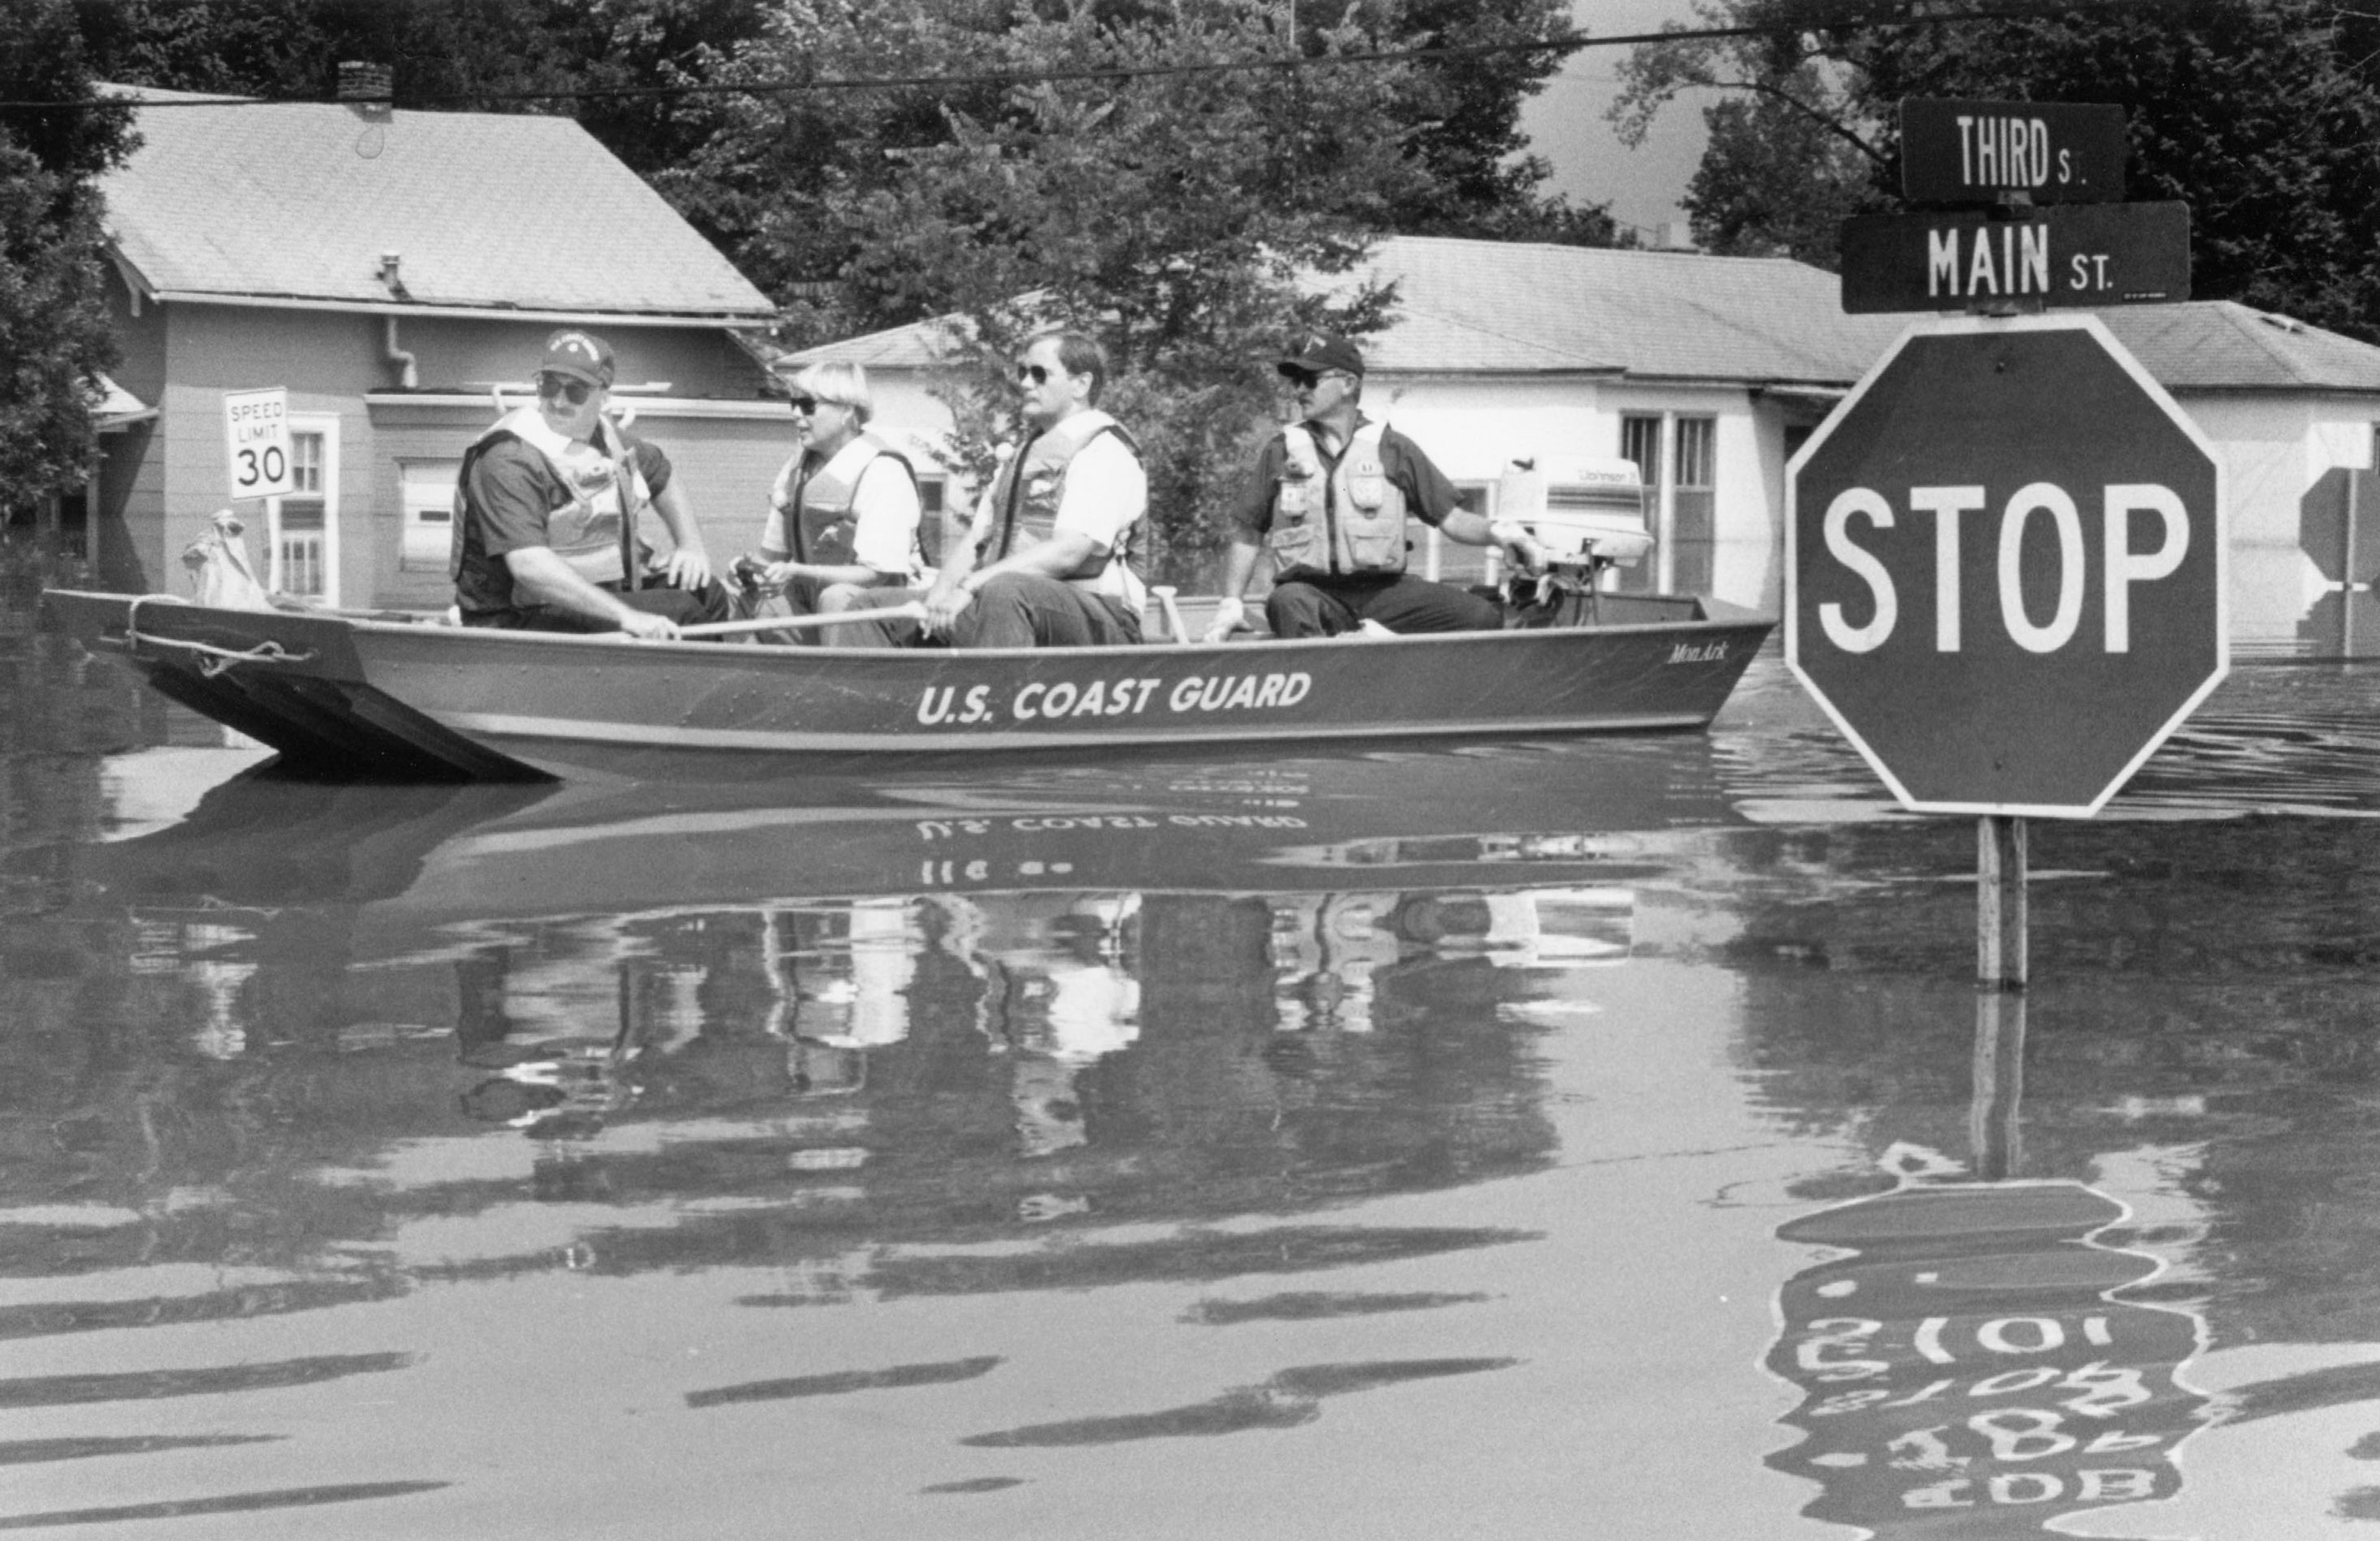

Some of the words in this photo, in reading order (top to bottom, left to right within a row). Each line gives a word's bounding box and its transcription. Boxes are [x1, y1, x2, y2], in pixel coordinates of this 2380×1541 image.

[1957, 116, 2048, 187] THIRD
[1929, 224, 2048, 296] MAIN
[2070, 254, 2113, 291] ST.
[231, 402, 282, 422] SPEED
[238, 423, 279, 443] LIMIT
[238, 446, 284, 487] 30
[1819, 482, 2190, 653] STOP
[917, 685, 994, 725] U.S.
[1013, 678, 1161, 720] COAST
[1169, 672, 1312, 712] GUARD
